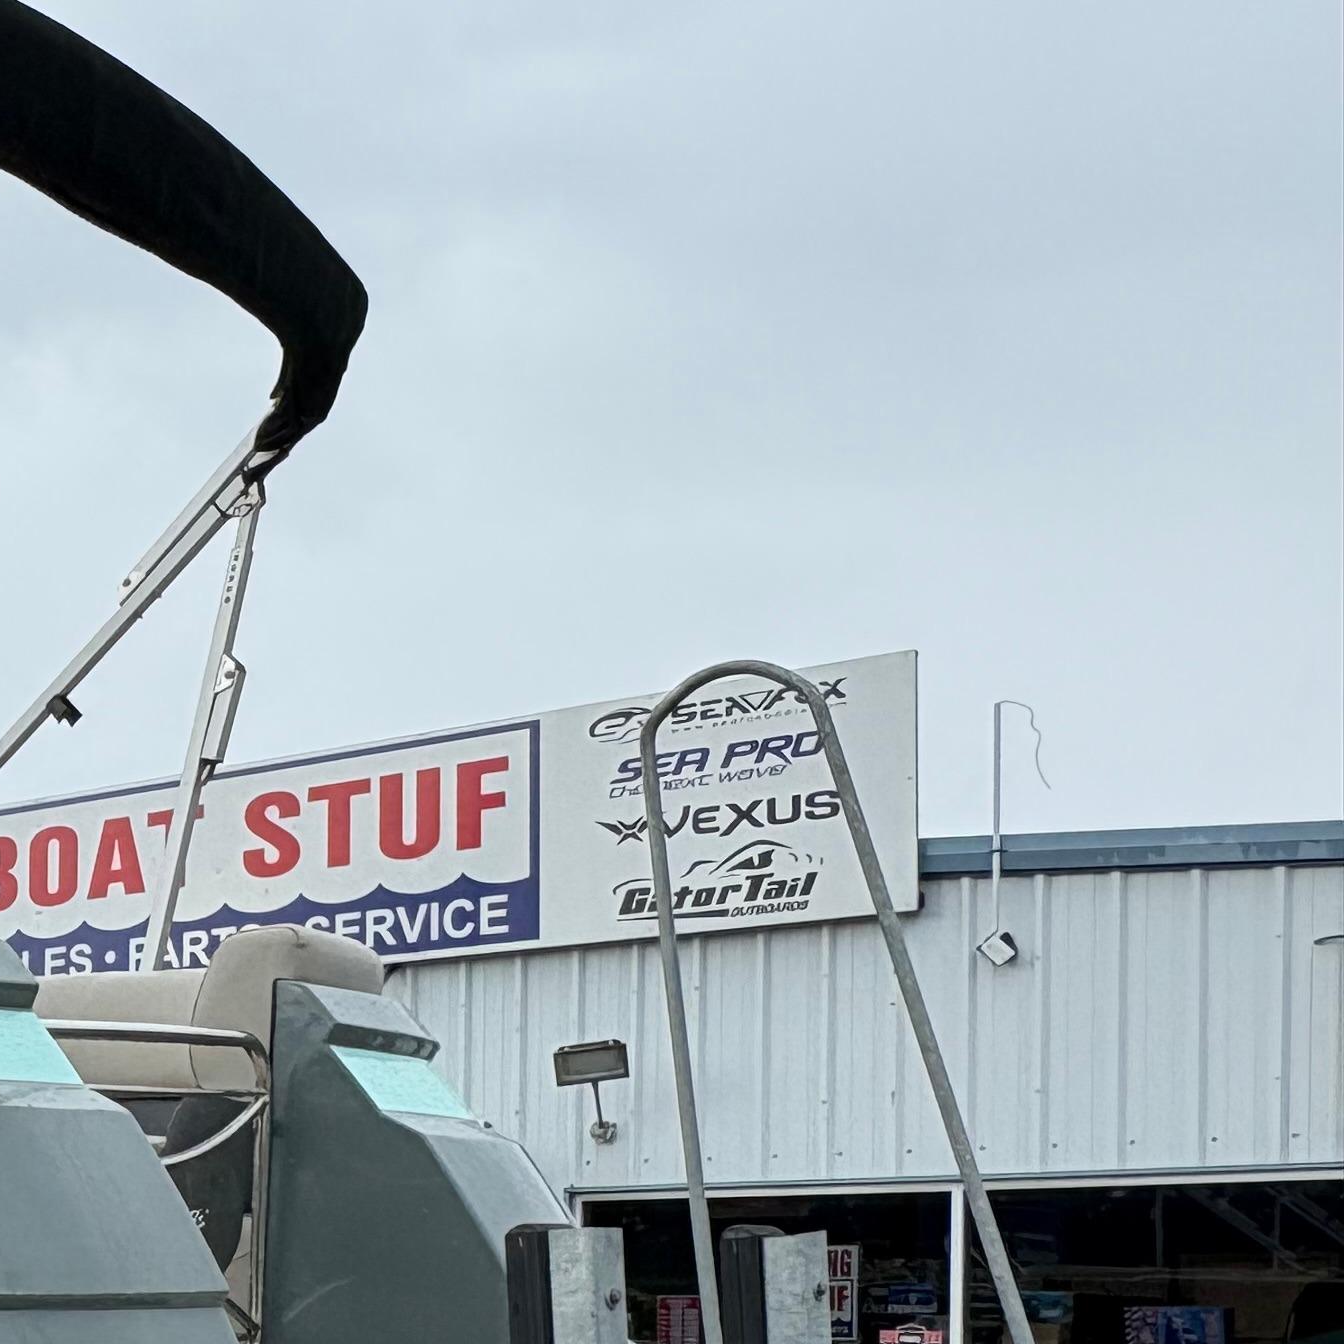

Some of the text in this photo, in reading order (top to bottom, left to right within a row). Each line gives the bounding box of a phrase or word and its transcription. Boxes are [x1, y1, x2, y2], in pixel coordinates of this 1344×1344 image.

[671, 697, 751, 725] SEA
[609, 731, 824, 784] SEA PRO
[242, 756, 509, 878] STUF
[662, 790, 841, 838] VEXUS
[618, 871, 818, 914] GtorTail
